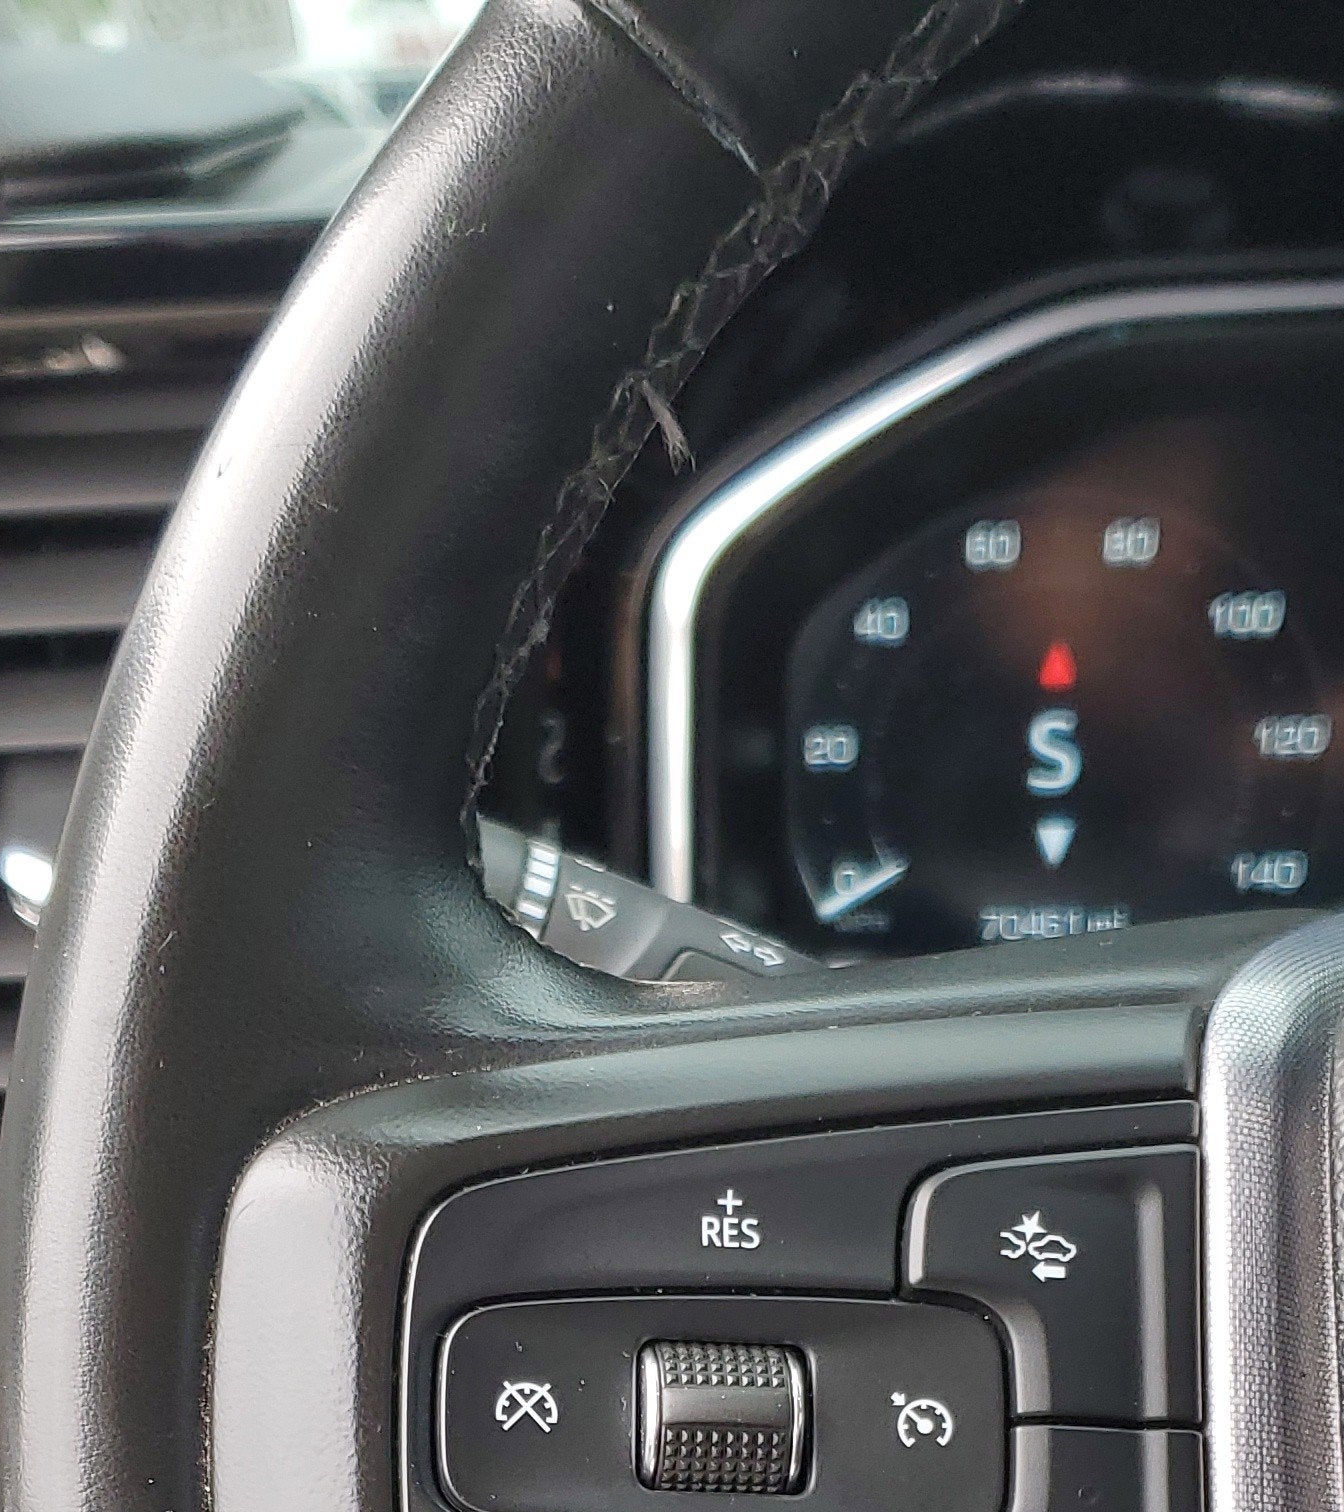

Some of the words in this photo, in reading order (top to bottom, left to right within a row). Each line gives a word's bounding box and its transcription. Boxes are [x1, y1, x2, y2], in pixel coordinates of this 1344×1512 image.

[855, 596, 909, 647] 40
[1208, 589, 1286, 639] 100
[803, 724, 857, 771] 20
[1027, 708, 1082, 797] S
[1254, 713, 1331, 759] 120
[1231, 849, 1308, 893] 140
[701, 1217, 761, 1249] RES
